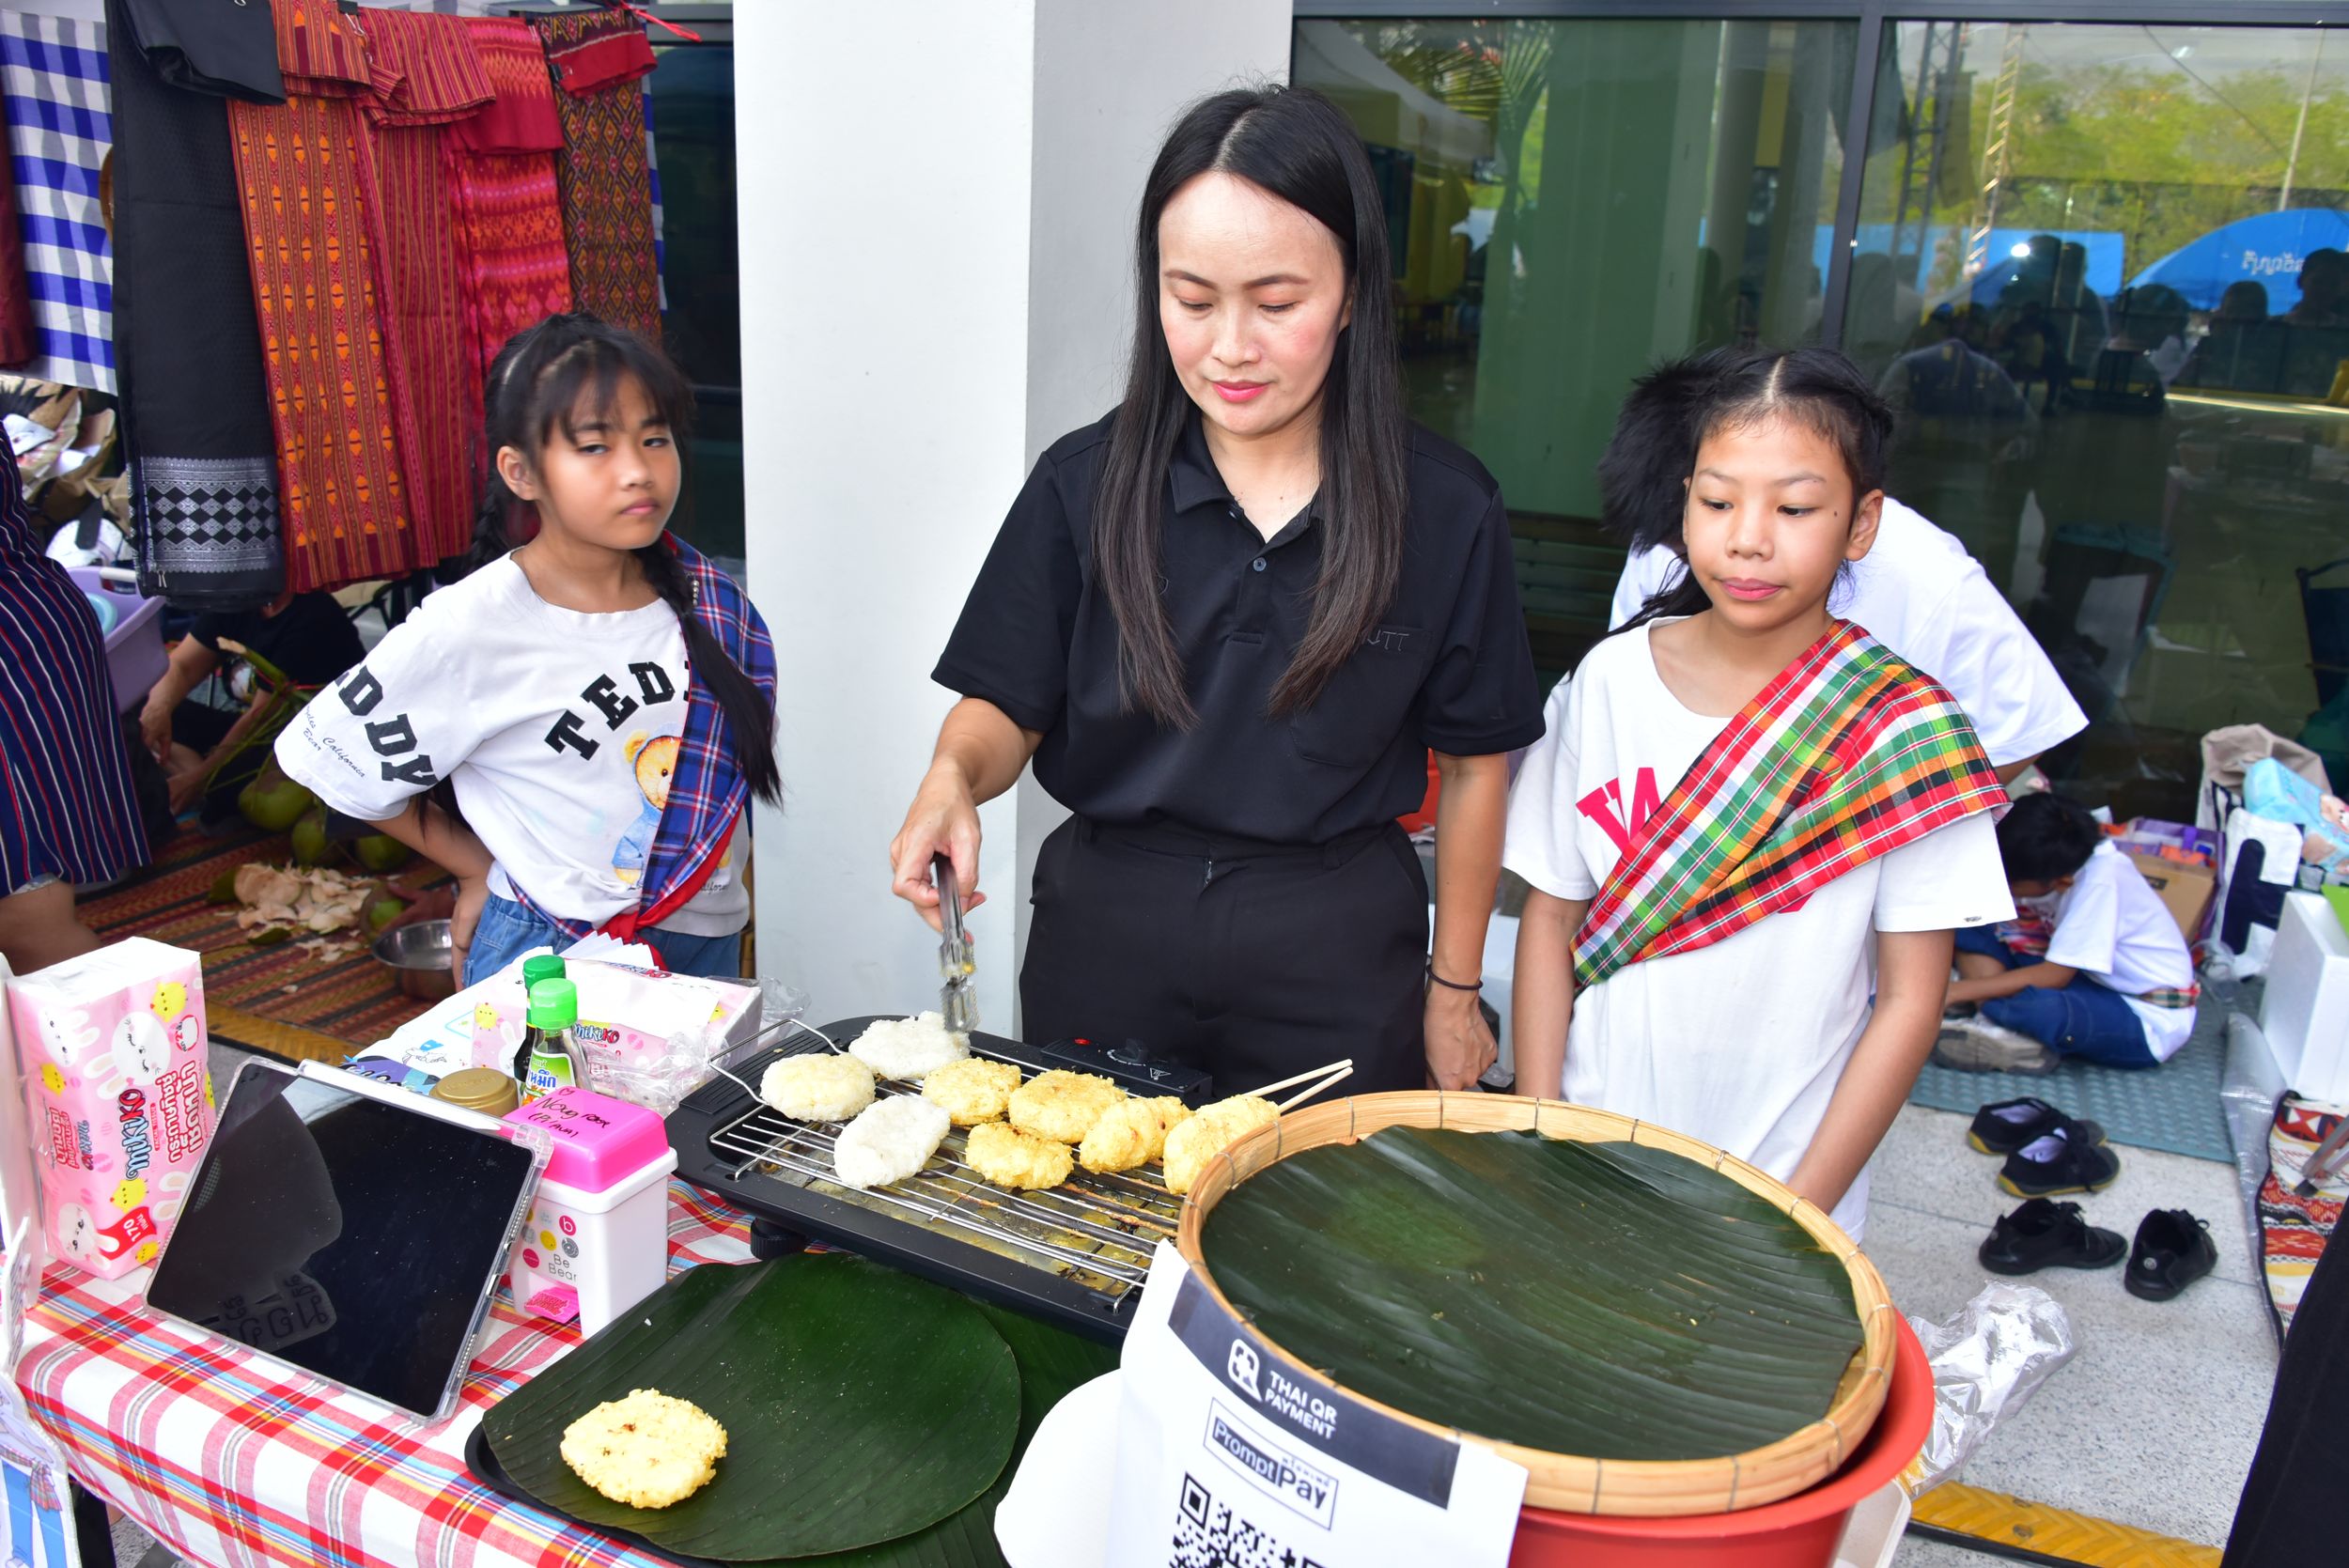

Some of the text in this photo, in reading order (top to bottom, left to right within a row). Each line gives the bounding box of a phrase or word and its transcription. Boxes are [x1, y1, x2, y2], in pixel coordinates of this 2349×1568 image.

[334, 663, 439, 786] DDY
[544, 661, 691, 761] TED
[322, 737, 366, 779] California
[124, 1218, 140, 1243] 170
[549, 1263, 576, 1282] Bear
[553, 1253, 570, 1268] Be
[1265, 1389, 1336, 1439] PAYMENT
[1270, 1371, 1338, 1425] THAI QR
